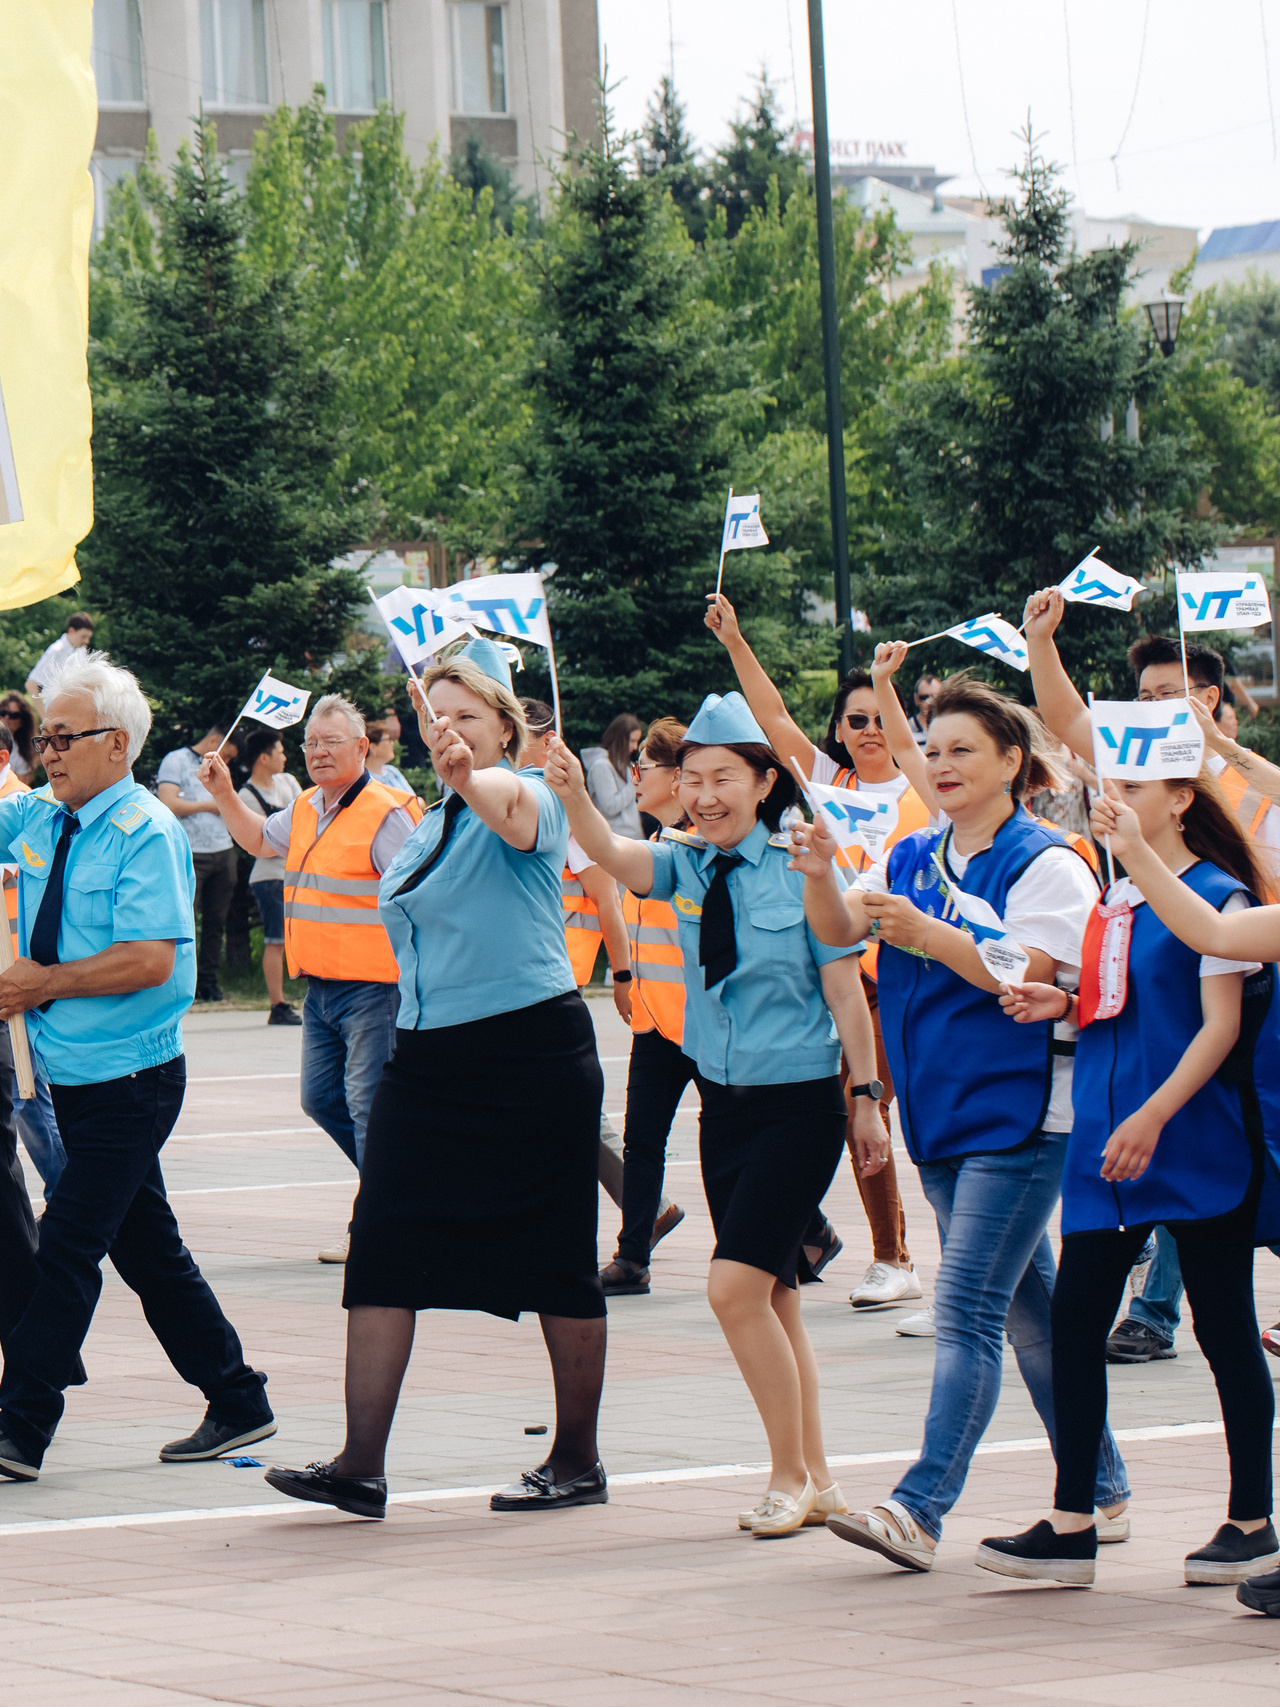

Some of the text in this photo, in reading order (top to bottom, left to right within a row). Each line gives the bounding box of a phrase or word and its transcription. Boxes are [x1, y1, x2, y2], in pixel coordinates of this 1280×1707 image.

[1181, 590, 1243, 620] УТ
[254, 689, 291, 715] УТ
[1097, 726, 1170, 767] УТ
